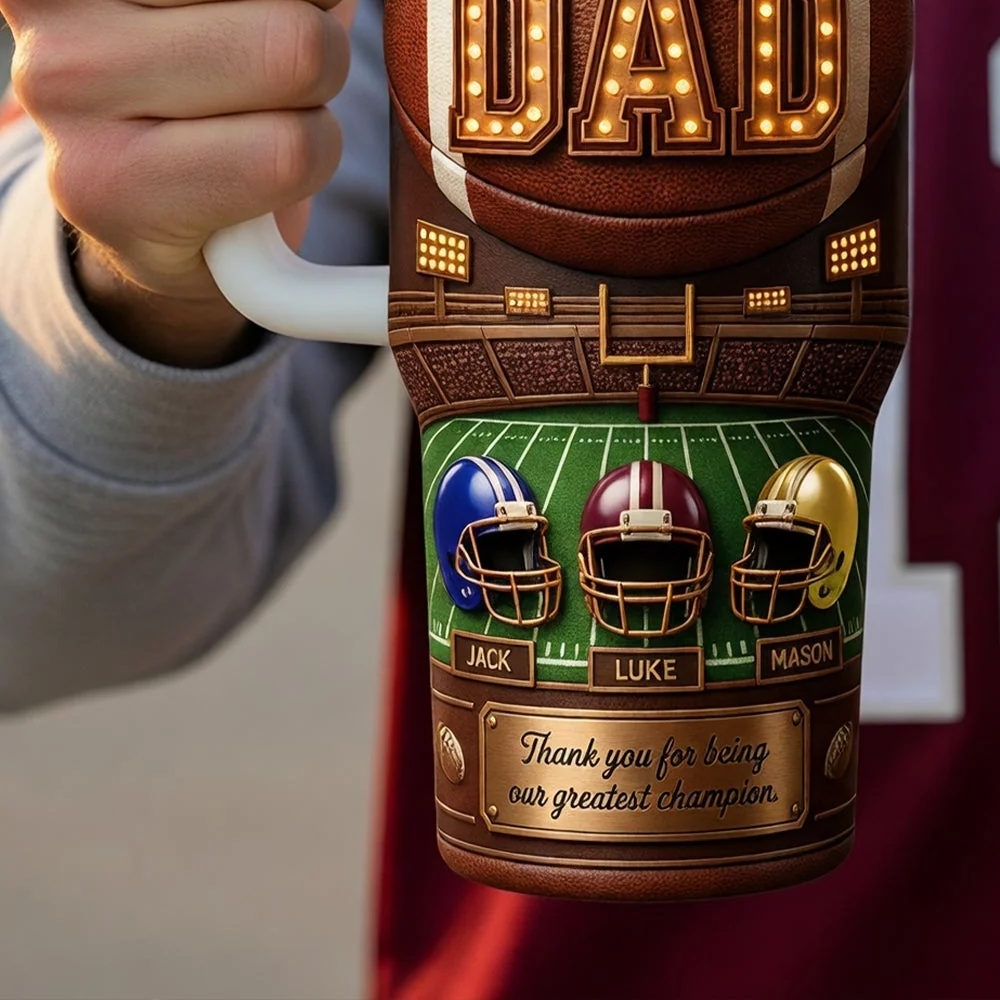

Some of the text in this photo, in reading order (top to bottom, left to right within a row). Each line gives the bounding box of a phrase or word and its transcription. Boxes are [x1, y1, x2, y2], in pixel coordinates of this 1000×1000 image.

[465, 644, 513, 673] JACK
[615, 659, 678, 682] LUKE
[770, 640, 834, 671] MASON
[519, 731, 770, 779] Thank you for being
[508, 786, 549, 806] our
[550, 784, 651, 819] greatest
